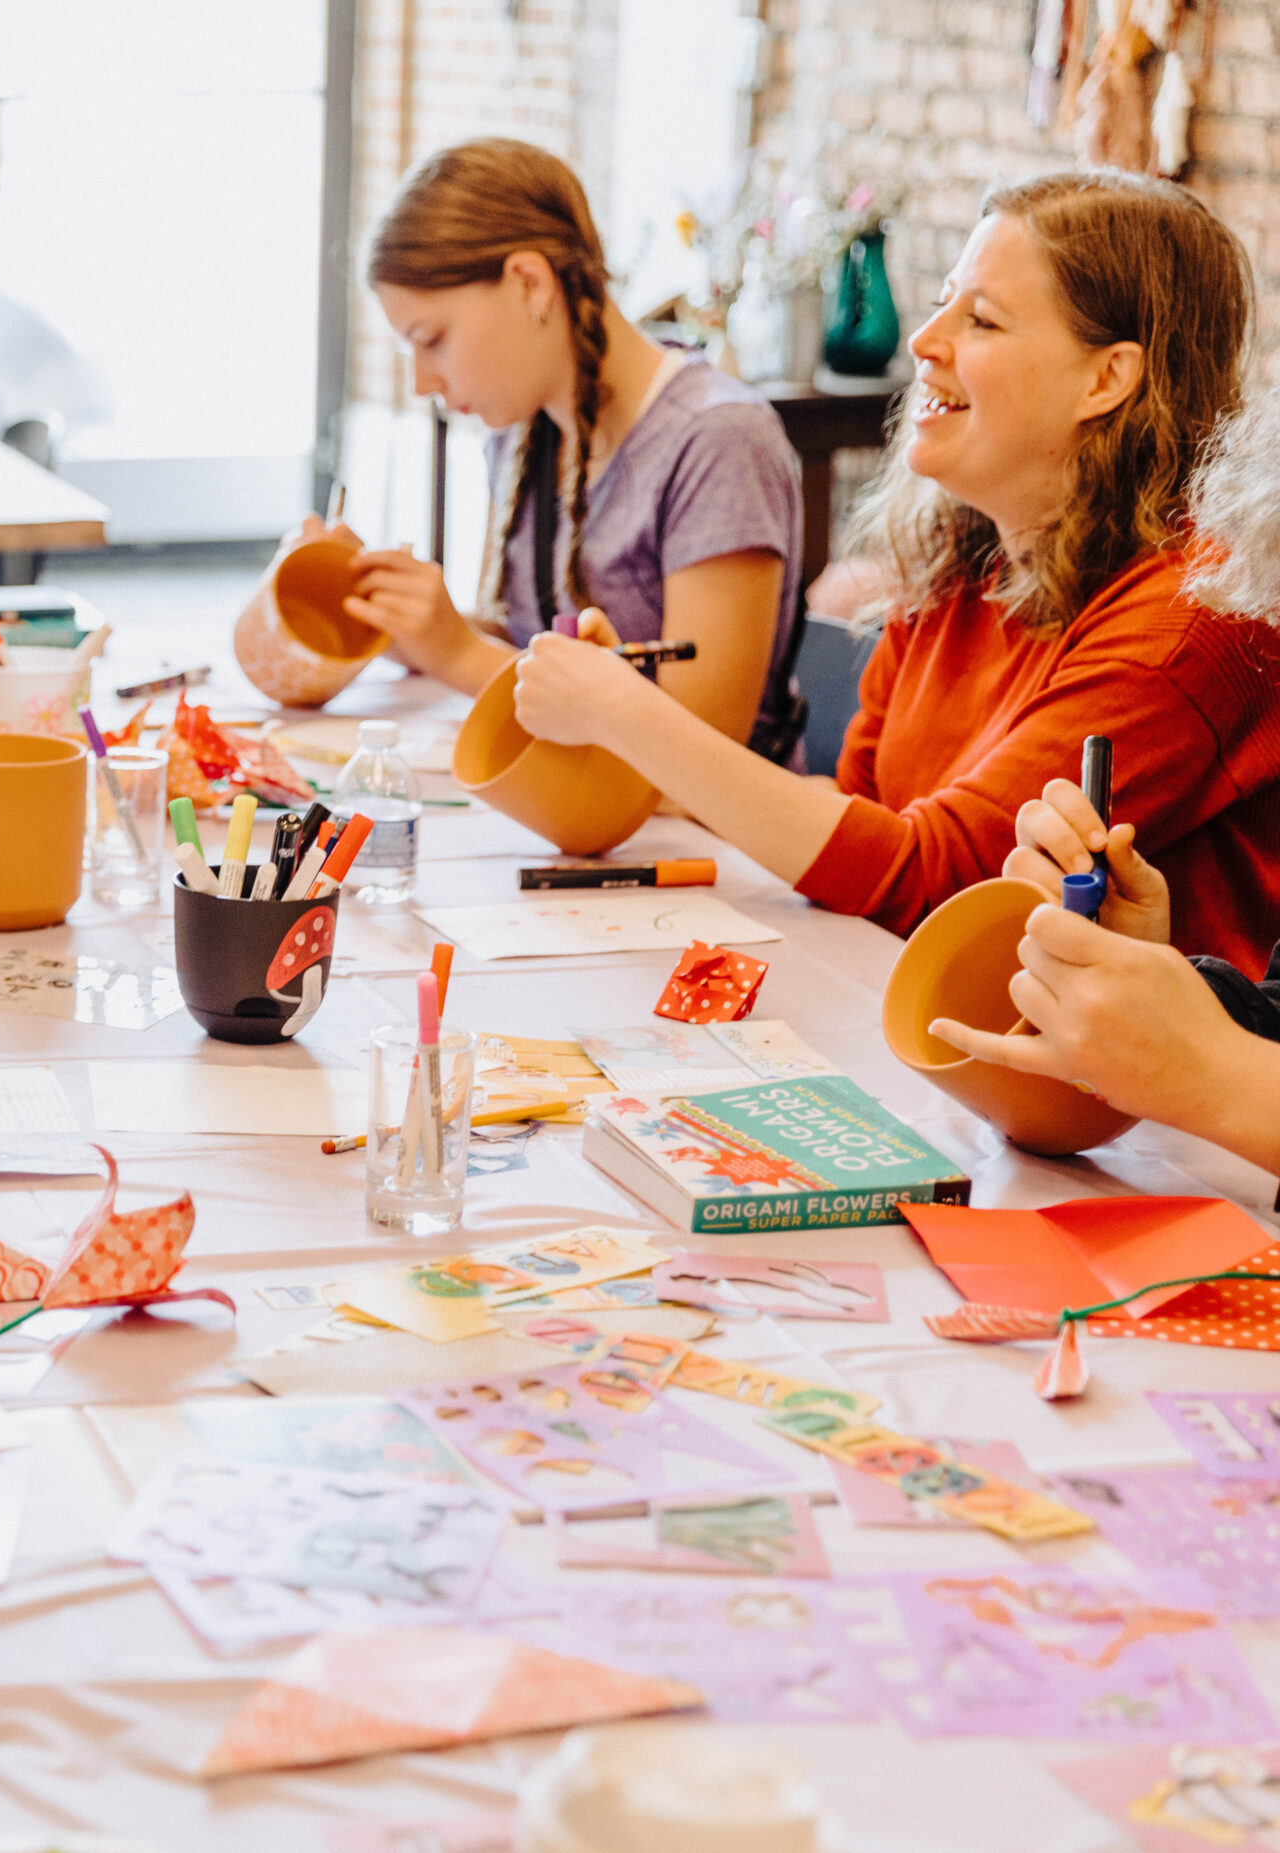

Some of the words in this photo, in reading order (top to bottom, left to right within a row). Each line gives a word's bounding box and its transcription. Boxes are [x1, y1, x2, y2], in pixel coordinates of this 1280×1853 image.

[721, 1094, 870, 1171] ORIGAMI
[758, 1088, 911, 1167] FLOWERS
[829, 1106, 879, 1133] PAPER
[876, 1132, 928, 1160] SUPER
[702, 1199, 799, 1221] ORIGAMI
[806, 1191, 912, 1214] FLOWERS
[747, 1215, 803, 1230] SUPER
[807, 1210, 862, 1226] PAPER
[866, 1208, 904, 1222] PAC
